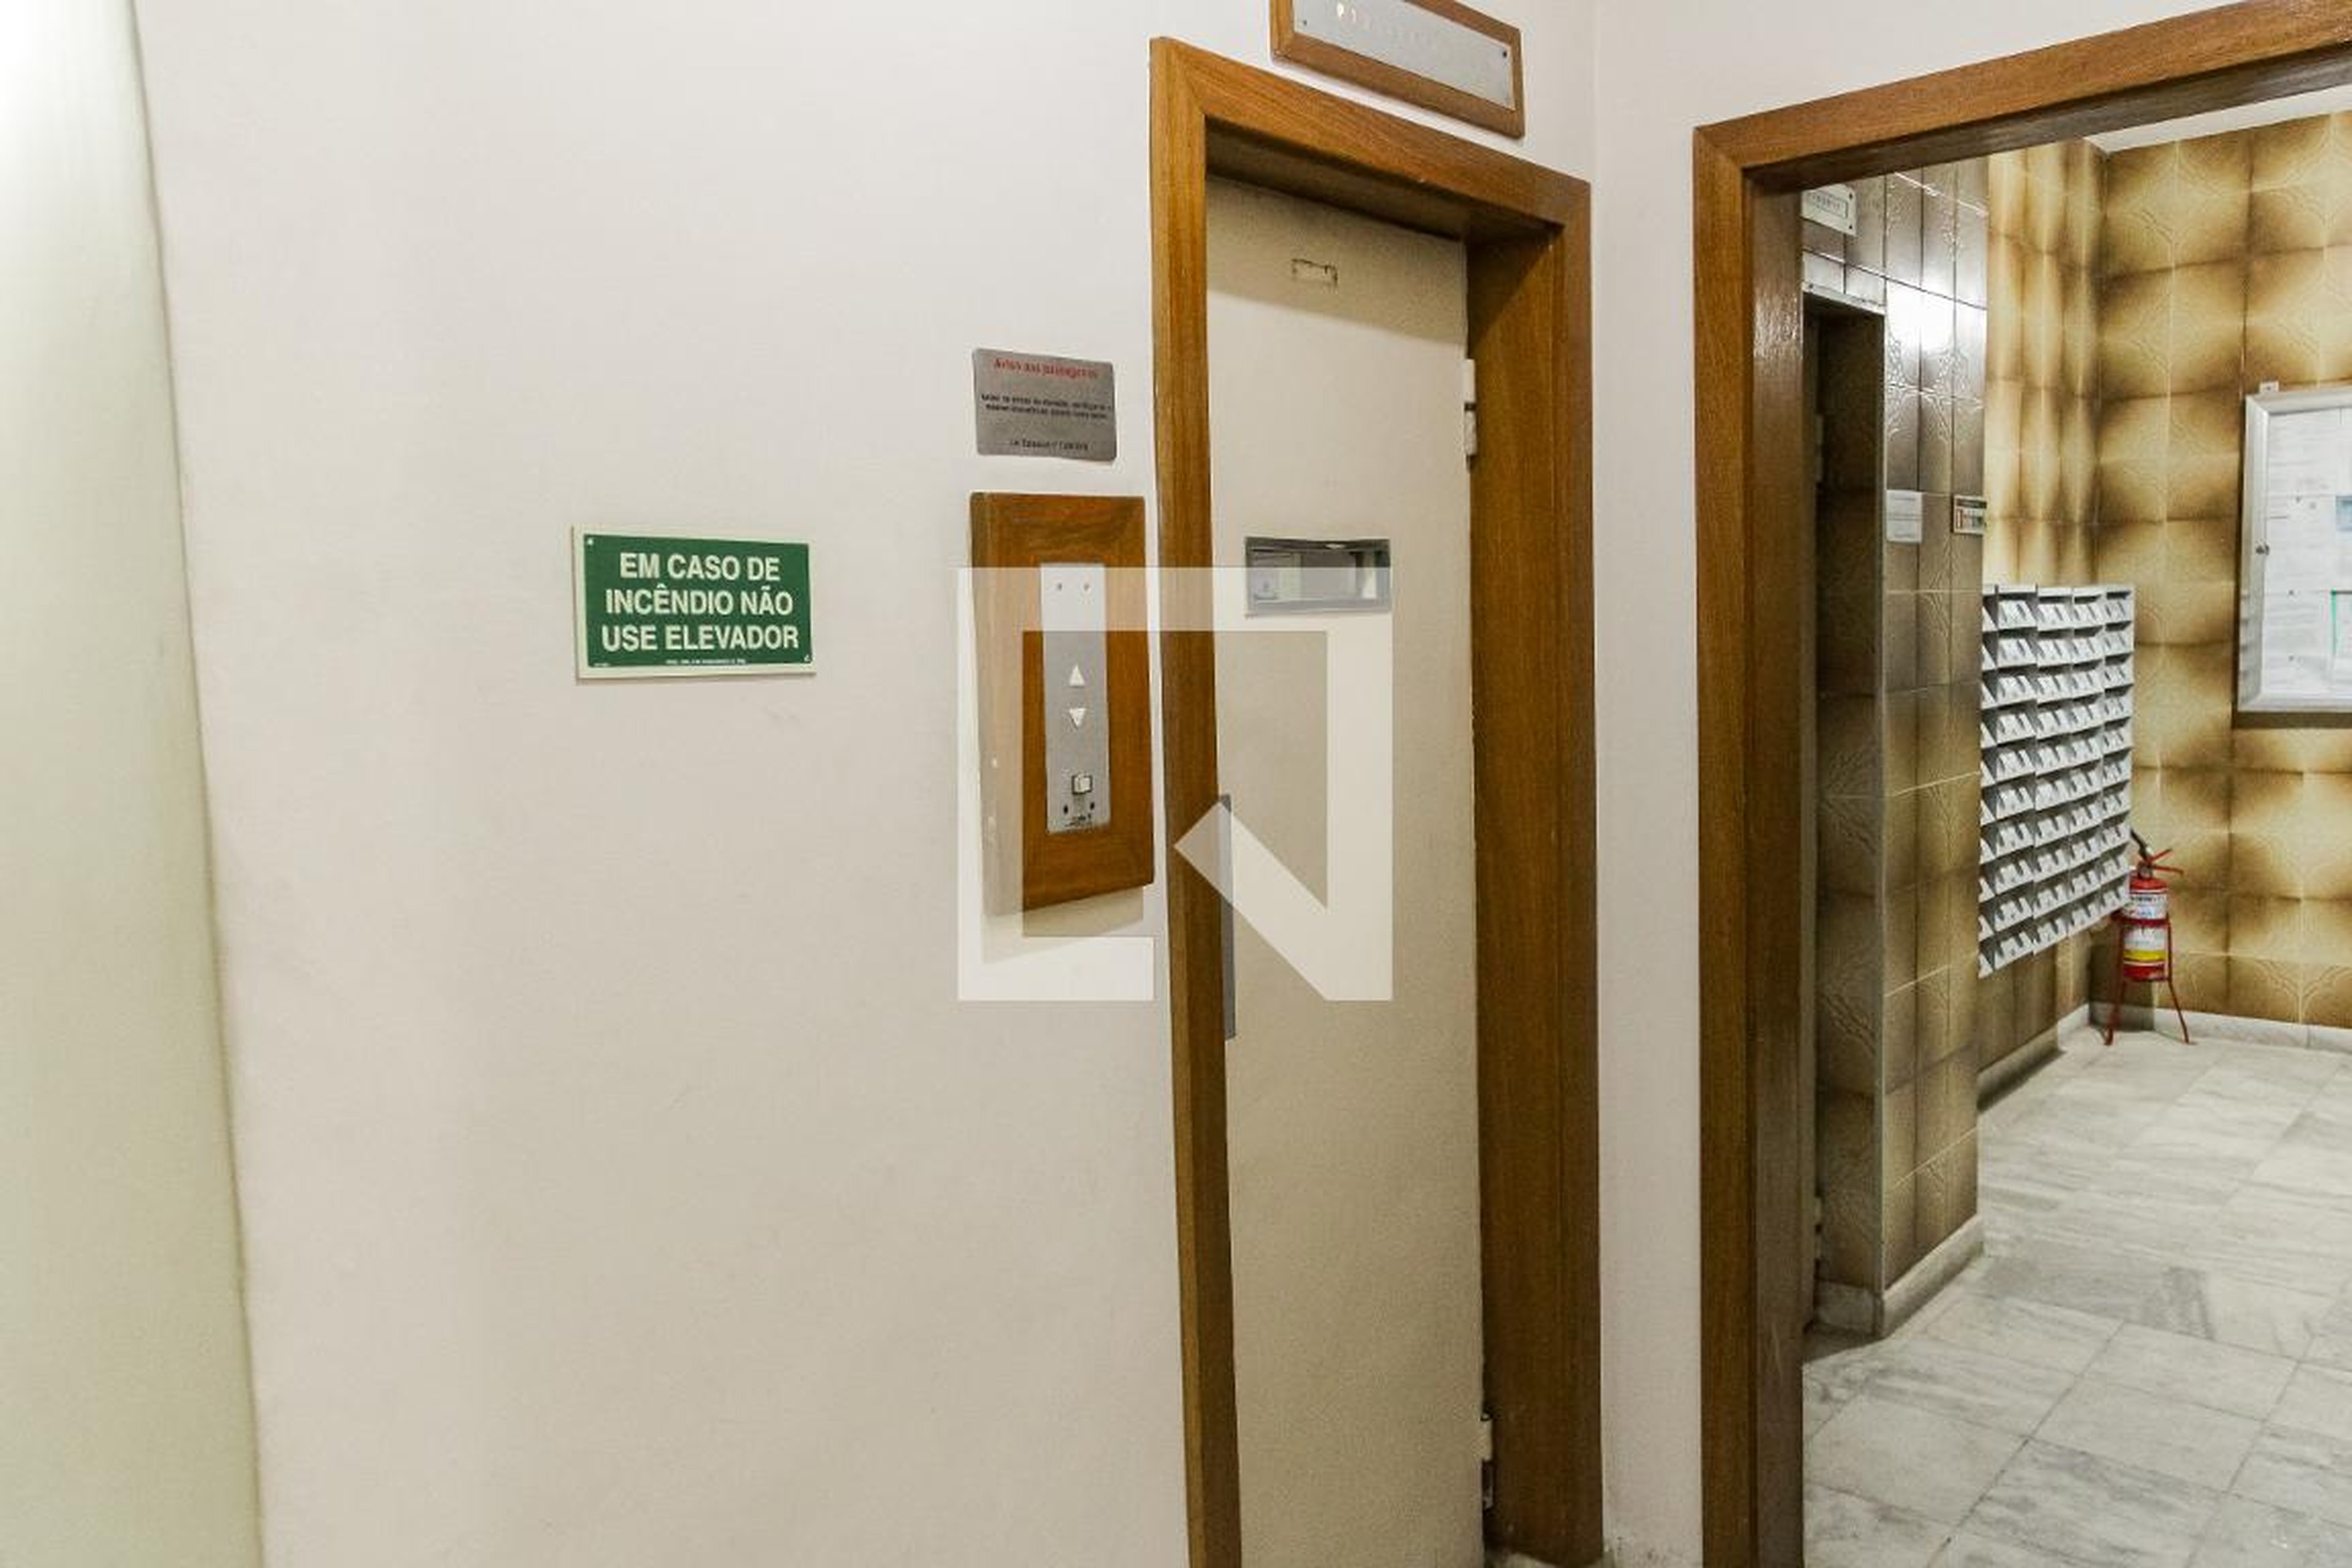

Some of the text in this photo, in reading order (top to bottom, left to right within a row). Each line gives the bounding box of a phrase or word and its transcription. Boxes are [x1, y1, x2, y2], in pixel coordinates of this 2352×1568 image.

[620, 552, 780, 581] EM CASO DE
[606, 583, 793, 615] INCÊNDIO NÃO
[601, 625, 799, 651] USE ELEVADOR
